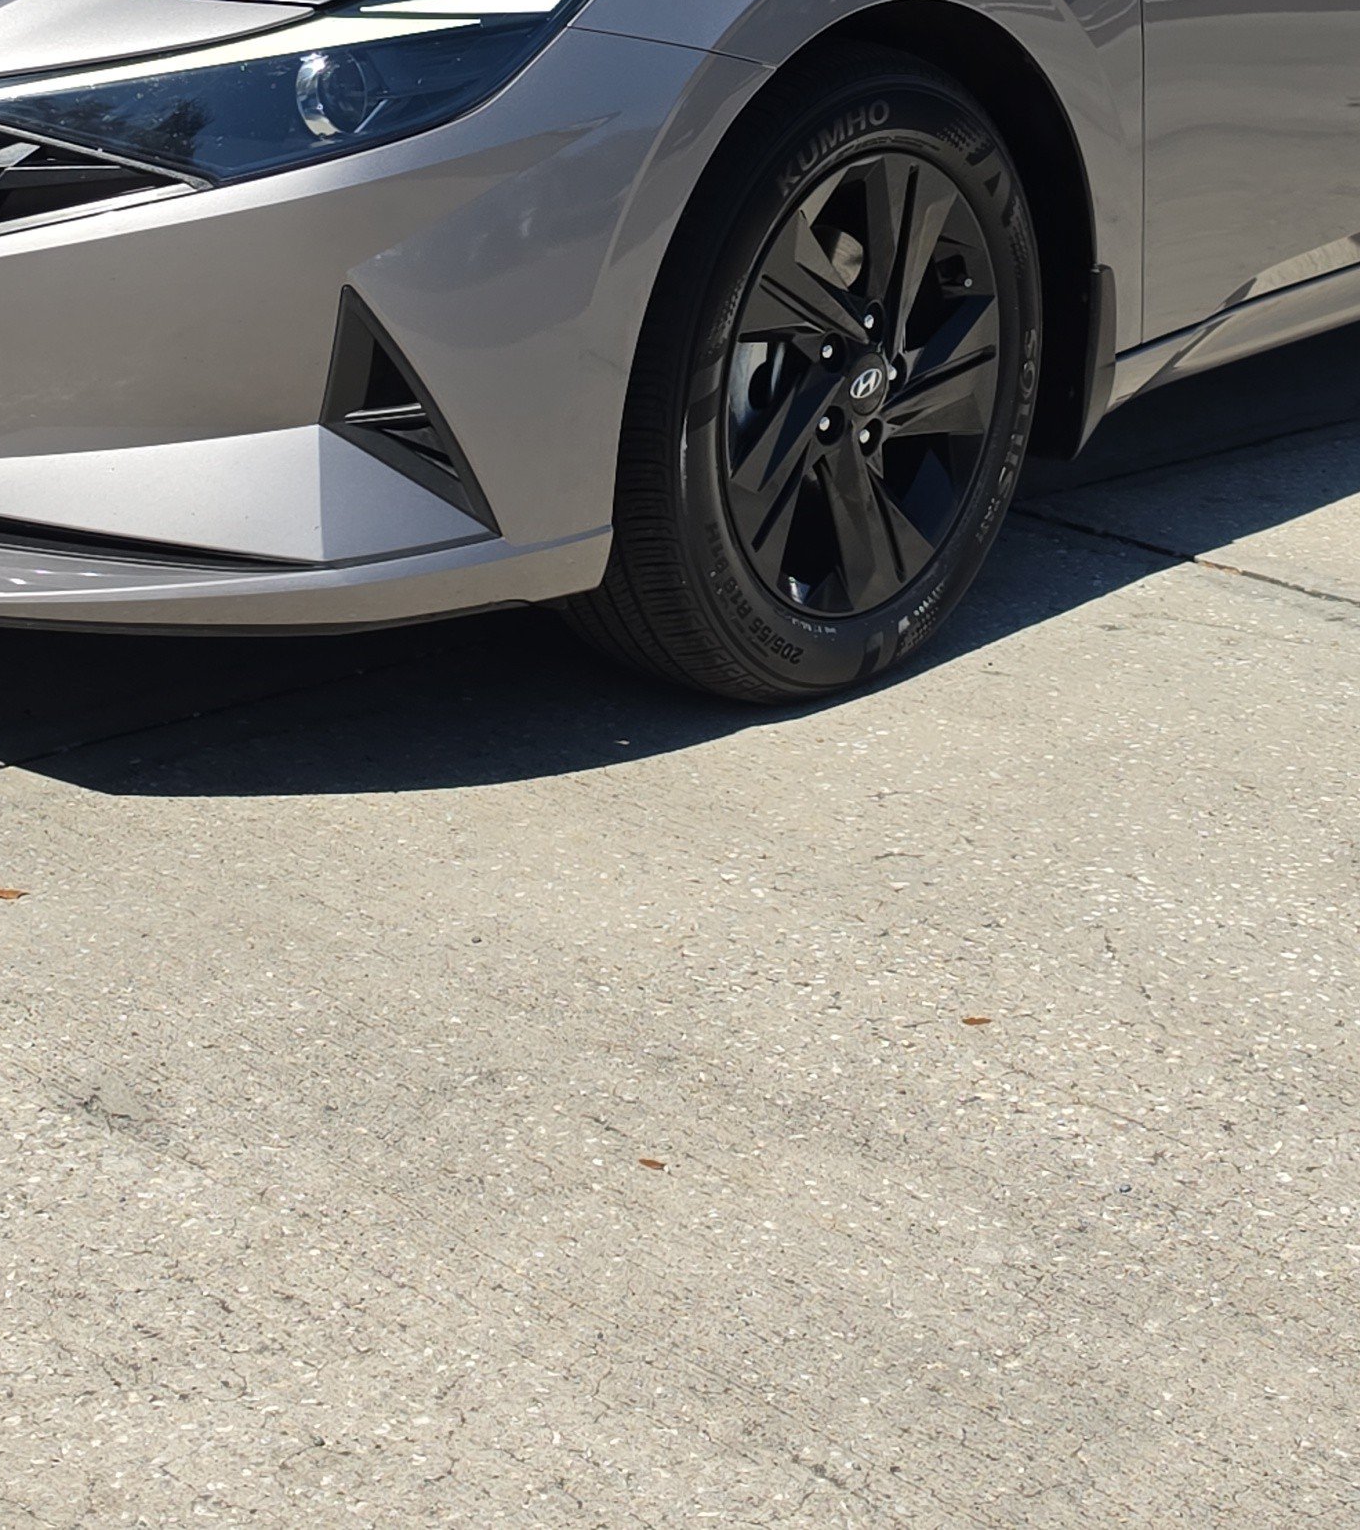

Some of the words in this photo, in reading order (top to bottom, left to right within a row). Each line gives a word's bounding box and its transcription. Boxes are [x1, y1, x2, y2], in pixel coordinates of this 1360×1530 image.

[780, 99, 890, 198] KUMHO
[997, 328, 1037, 500] SOLUS
[748, 618, 804, 665] 205/55
